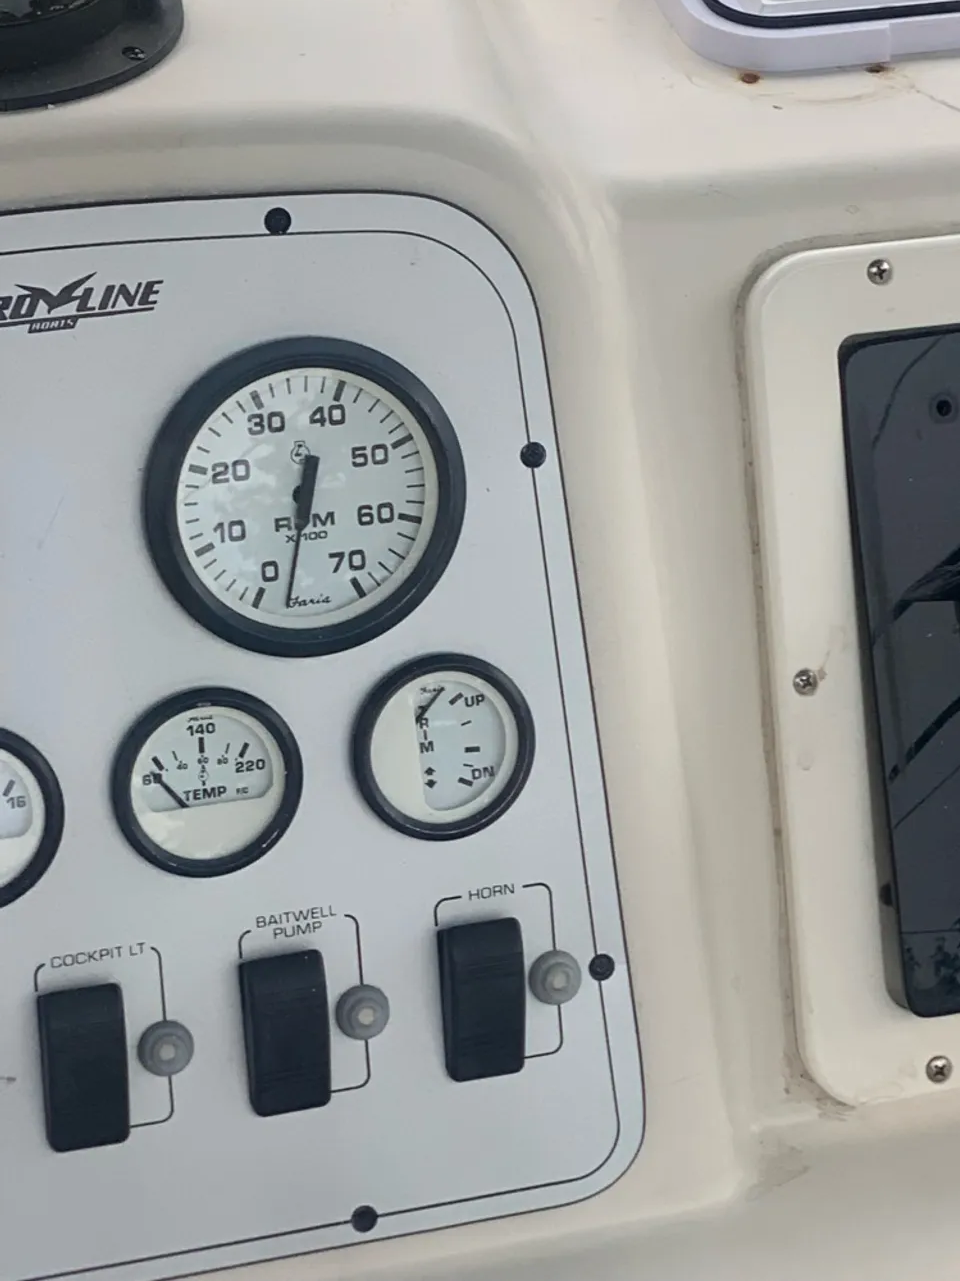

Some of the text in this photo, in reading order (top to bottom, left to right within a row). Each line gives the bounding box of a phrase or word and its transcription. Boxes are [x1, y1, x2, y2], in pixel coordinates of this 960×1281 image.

[247, 410, 286, 436] 30
[309, 403, 347, 428] 40
[351, 443, 389, 468] 50
[211, 458, 250, 485] 20
[274, 511, 336, 533] RM
[356, 501, 395, 527] 60
[212, 518, 247, 544] 10
[261, 560, 280, 582] 0
[328, 549, 367, 574] 70
[464, 693, 486, 709] UP
[186, 722, 216, 736] 140
[235, 758, 266, 774] 220
[471, 765, 496, 781] DN
[6, 795, 27, 810] 16
[182, 785, 228, 802] TEMP
[467, 883, 516, 902] HORN
[255, 904, 338, 929] BAITWELL
[272, 920, 323, 940] PUMP
[49, 941, 147, 969] COCKPIT LT
